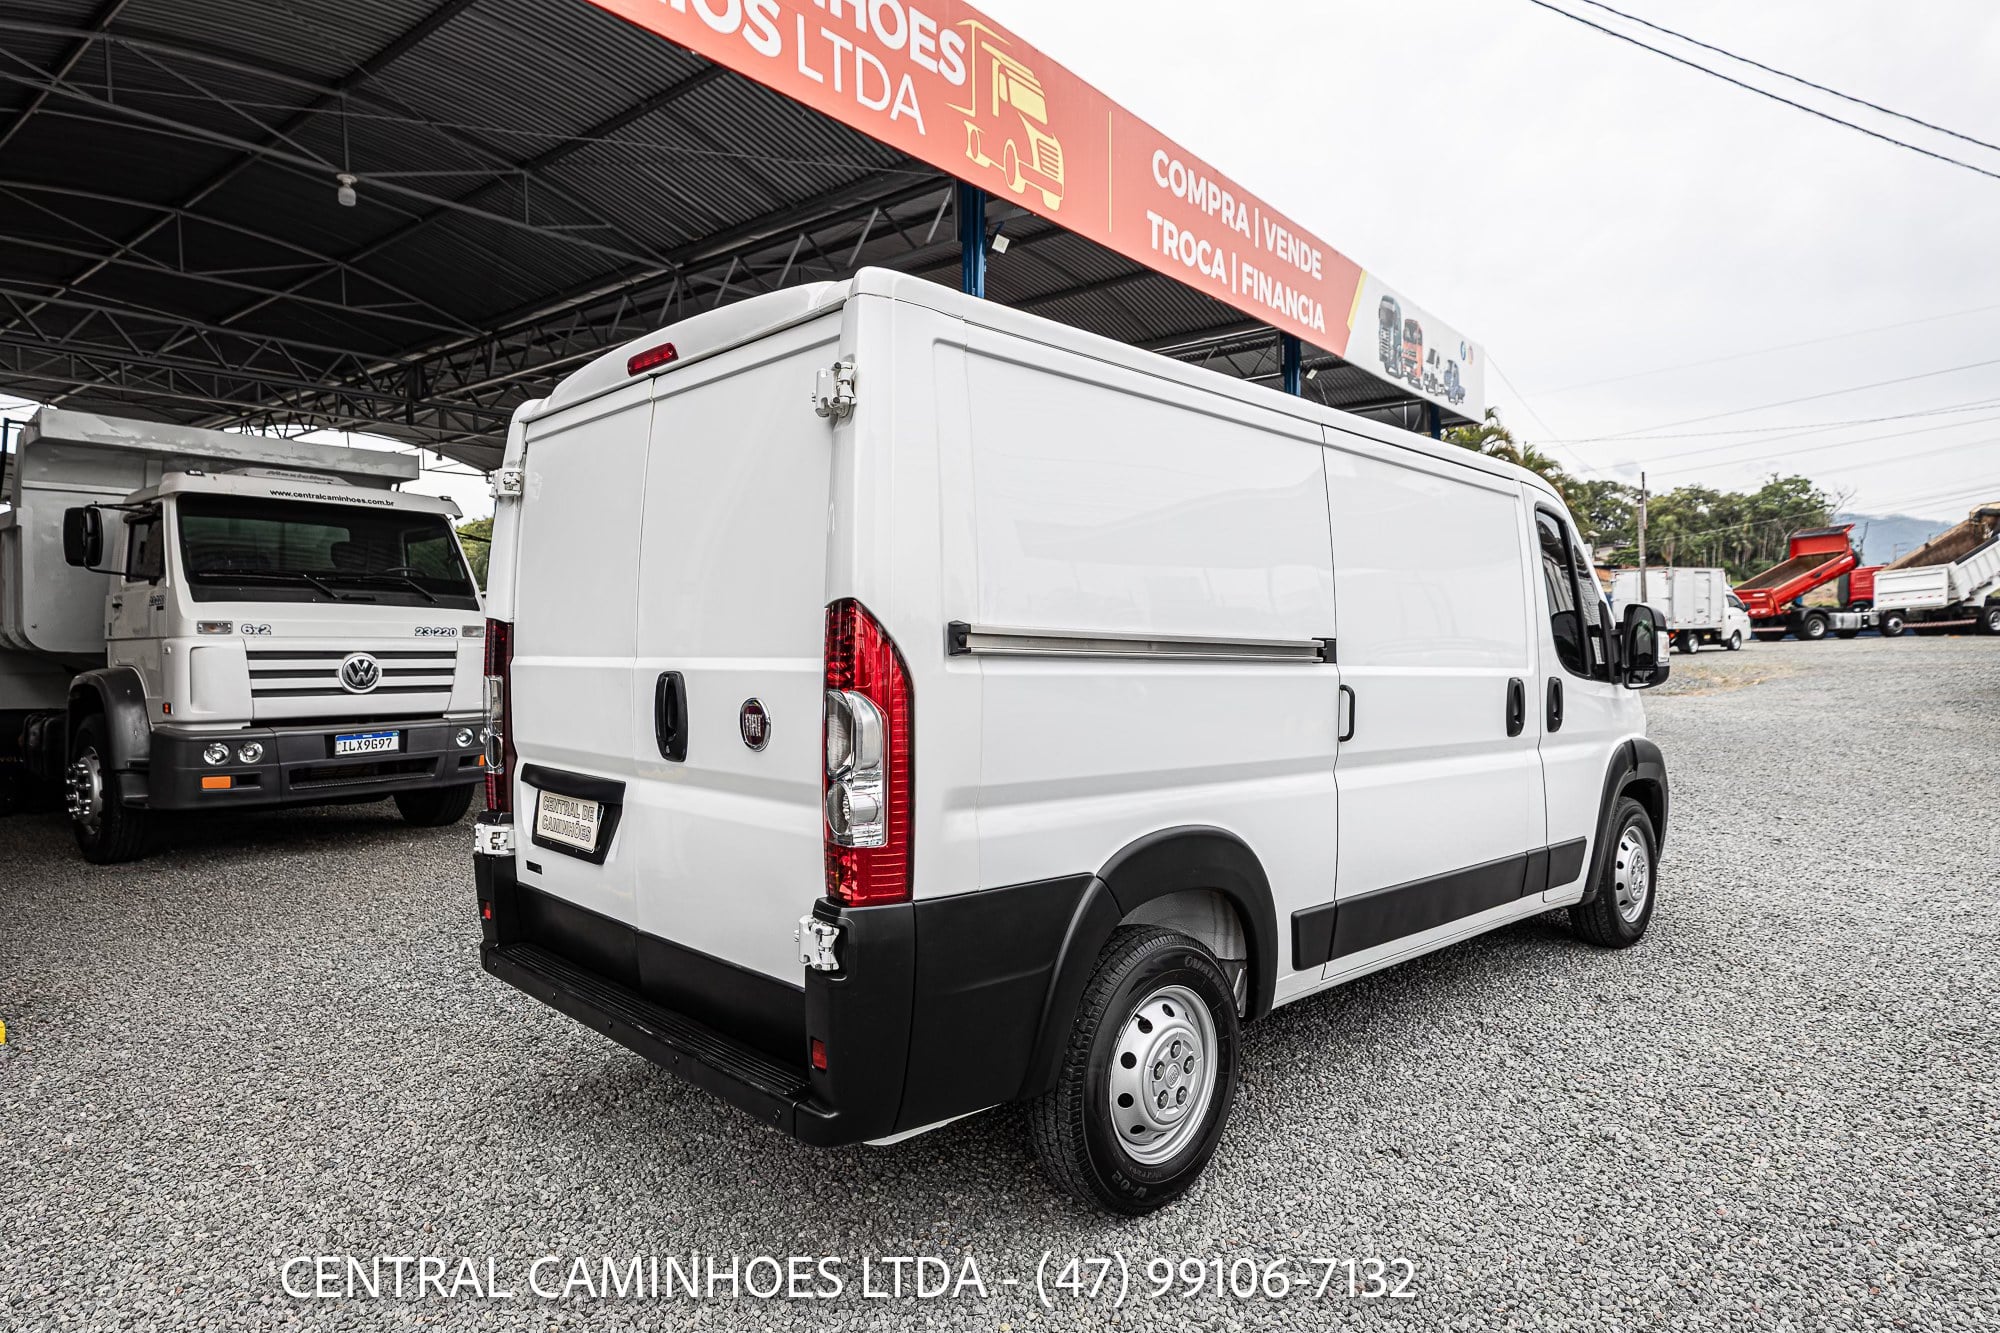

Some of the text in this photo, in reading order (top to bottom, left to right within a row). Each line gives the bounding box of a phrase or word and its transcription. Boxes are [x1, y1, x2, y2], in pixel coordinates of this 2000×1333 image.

[796, 13, 926, 136] LTDA
[1152, 149, 1251, 239] COMPRA
[1263, 217, 1323, 281] VENDE
[1146, 209, 1228, 285] TROCA
[1241, 261, 1326, 335] FINANCIA
[269, 489, 395, 507] www.centralcaminhoes.com.br
[241, 624, 272, 636] 6x2
[341, 738, 393, 753] ILX9G97
[542, 795, 595, 823] CENTRAL DE
[542, 814, 592, 843] CAMINHÕES
